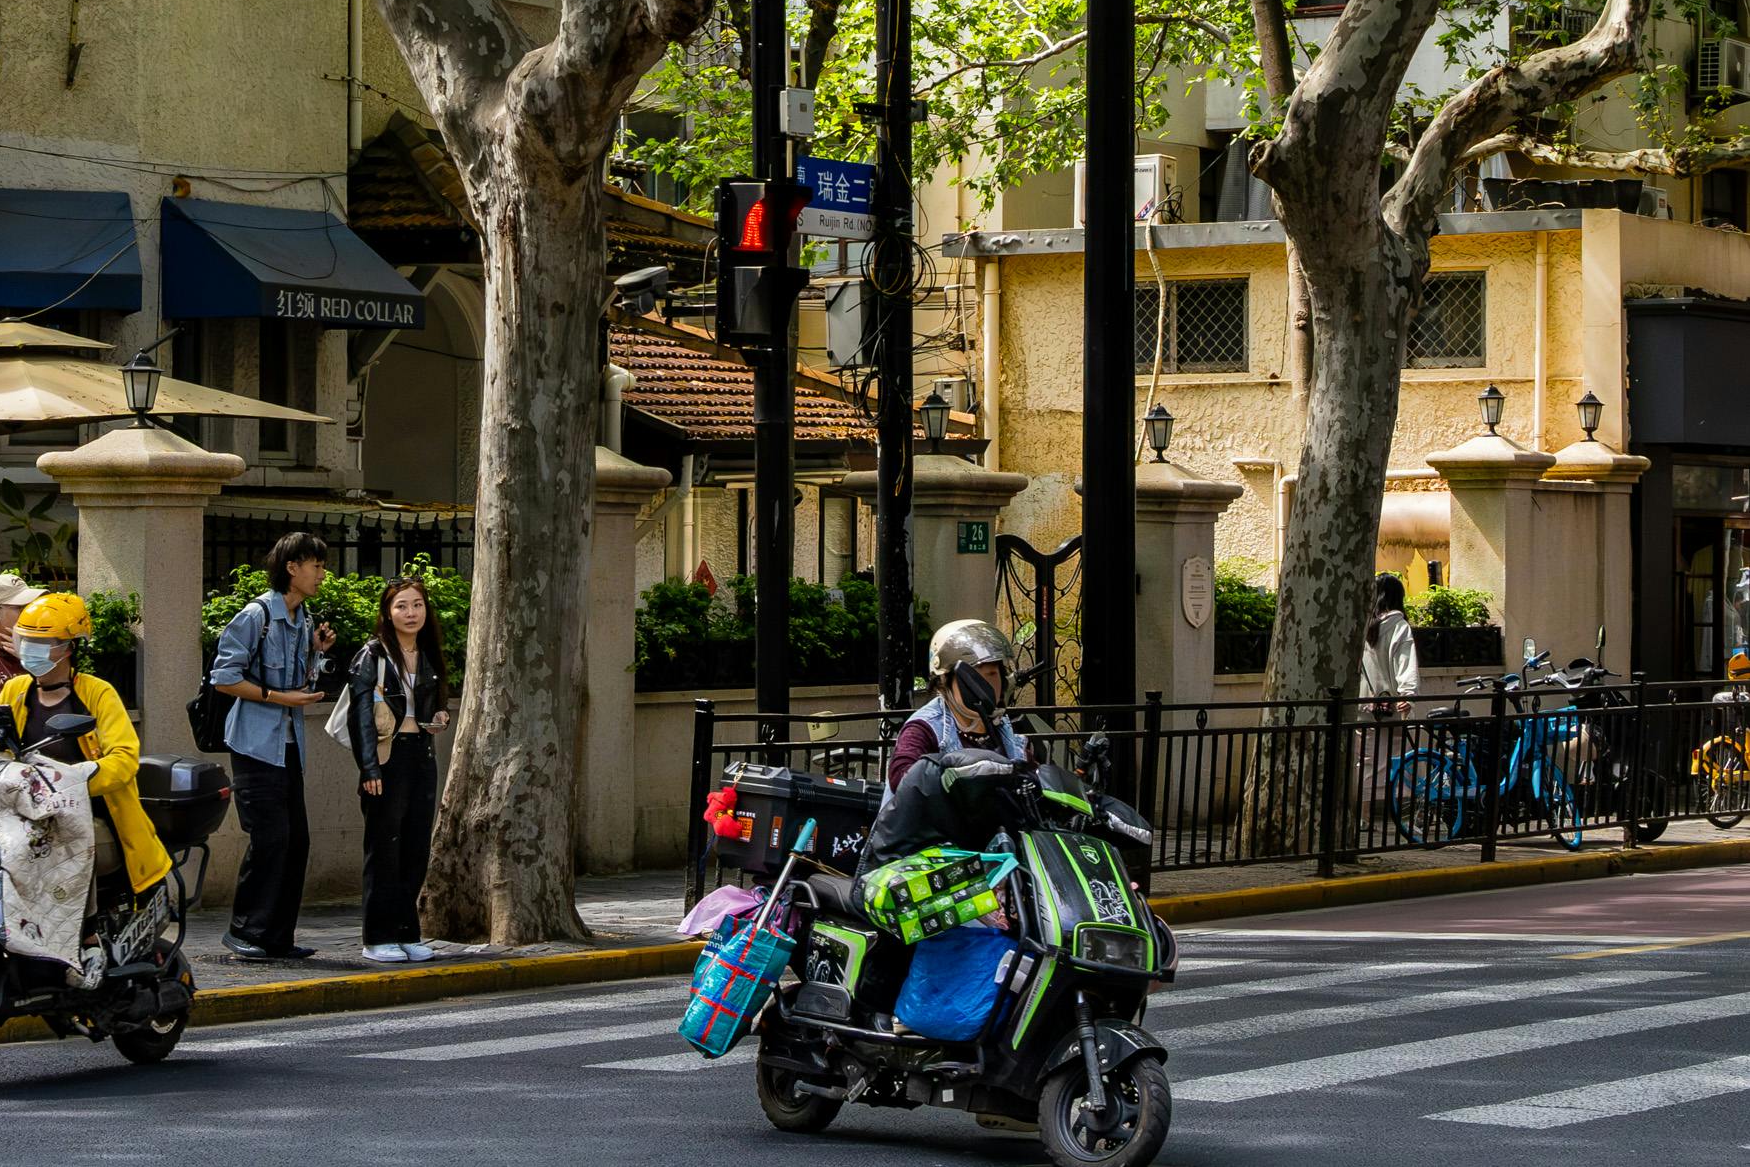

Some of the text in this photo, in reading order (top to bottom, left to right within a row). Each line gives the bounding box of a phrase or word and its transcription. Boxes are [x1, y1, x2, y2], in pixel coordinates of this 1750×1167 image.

[819, 214, 841, 231] Ruijin
[277, 289, 414, 324] 红领 RED COLLAR
[972, 524, 983, 541] 26
